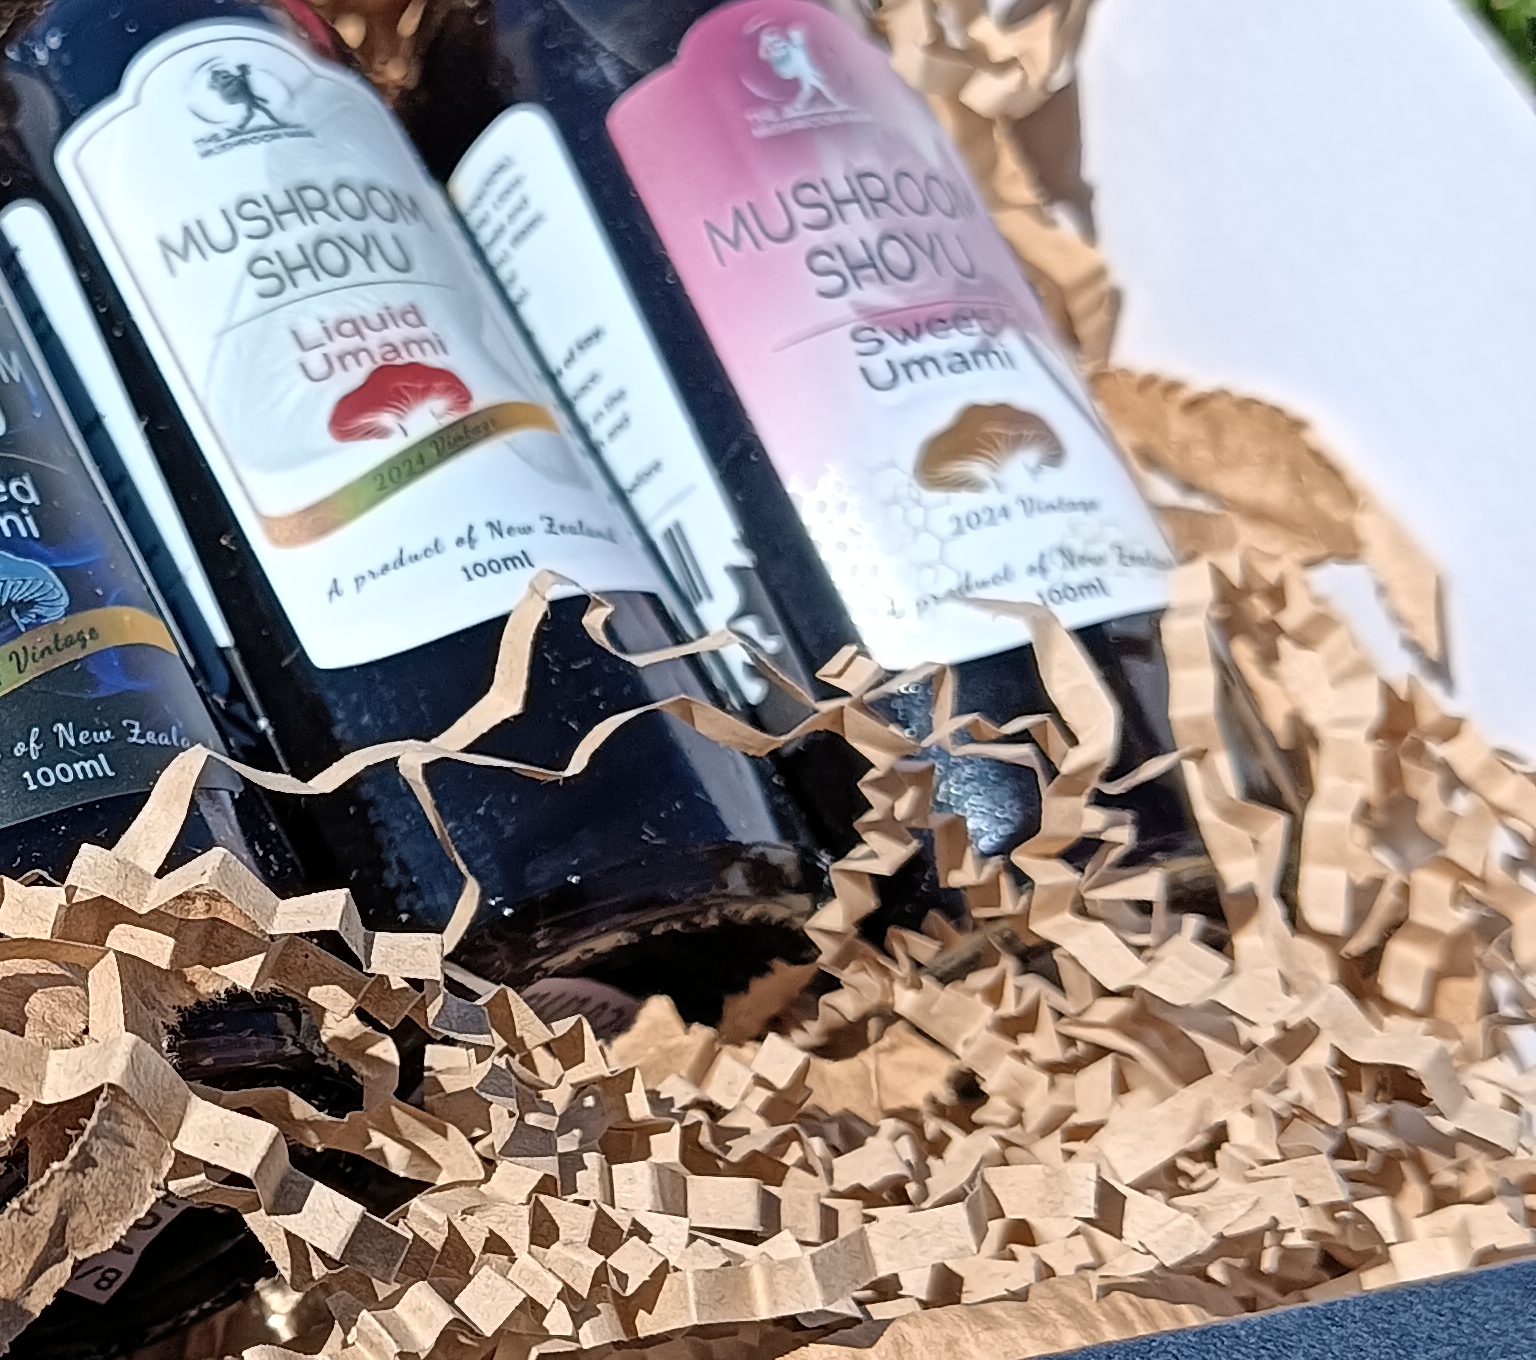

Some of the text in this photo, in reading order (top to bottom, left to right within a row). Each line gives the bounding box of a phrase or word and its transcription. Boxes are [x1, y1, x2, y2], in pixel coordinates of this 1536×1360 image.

[157, 182, 429, 277] MUSHROOM
[246, 233, 415, 298] SHOYU
[805, 229, 977, 300] SHOYU
[289, 302, 427, 353] Liquid
[850, 305, 1007, 357] Sweet
[299, 333, 451, 384] Umami
[861, 342, 1018, 392] Umami
[372, 452, 426, 493] 2024
[948, 503, 1011, 537] 2024
[327, 578, 345, 603] A
[353, 537, 444, 594] product
[454, 523, 478, 551] of
[484, 519, 535, 542] New
[460, 548, 537, 583] 100ml
[1036, 576, 1114, 608] 100ml
[8, 625, 101, 675] Vintage
[13, 727, 44, 760] of
[52, 722, 117, 757] New
[22, 752, 117, 791] 100ml
